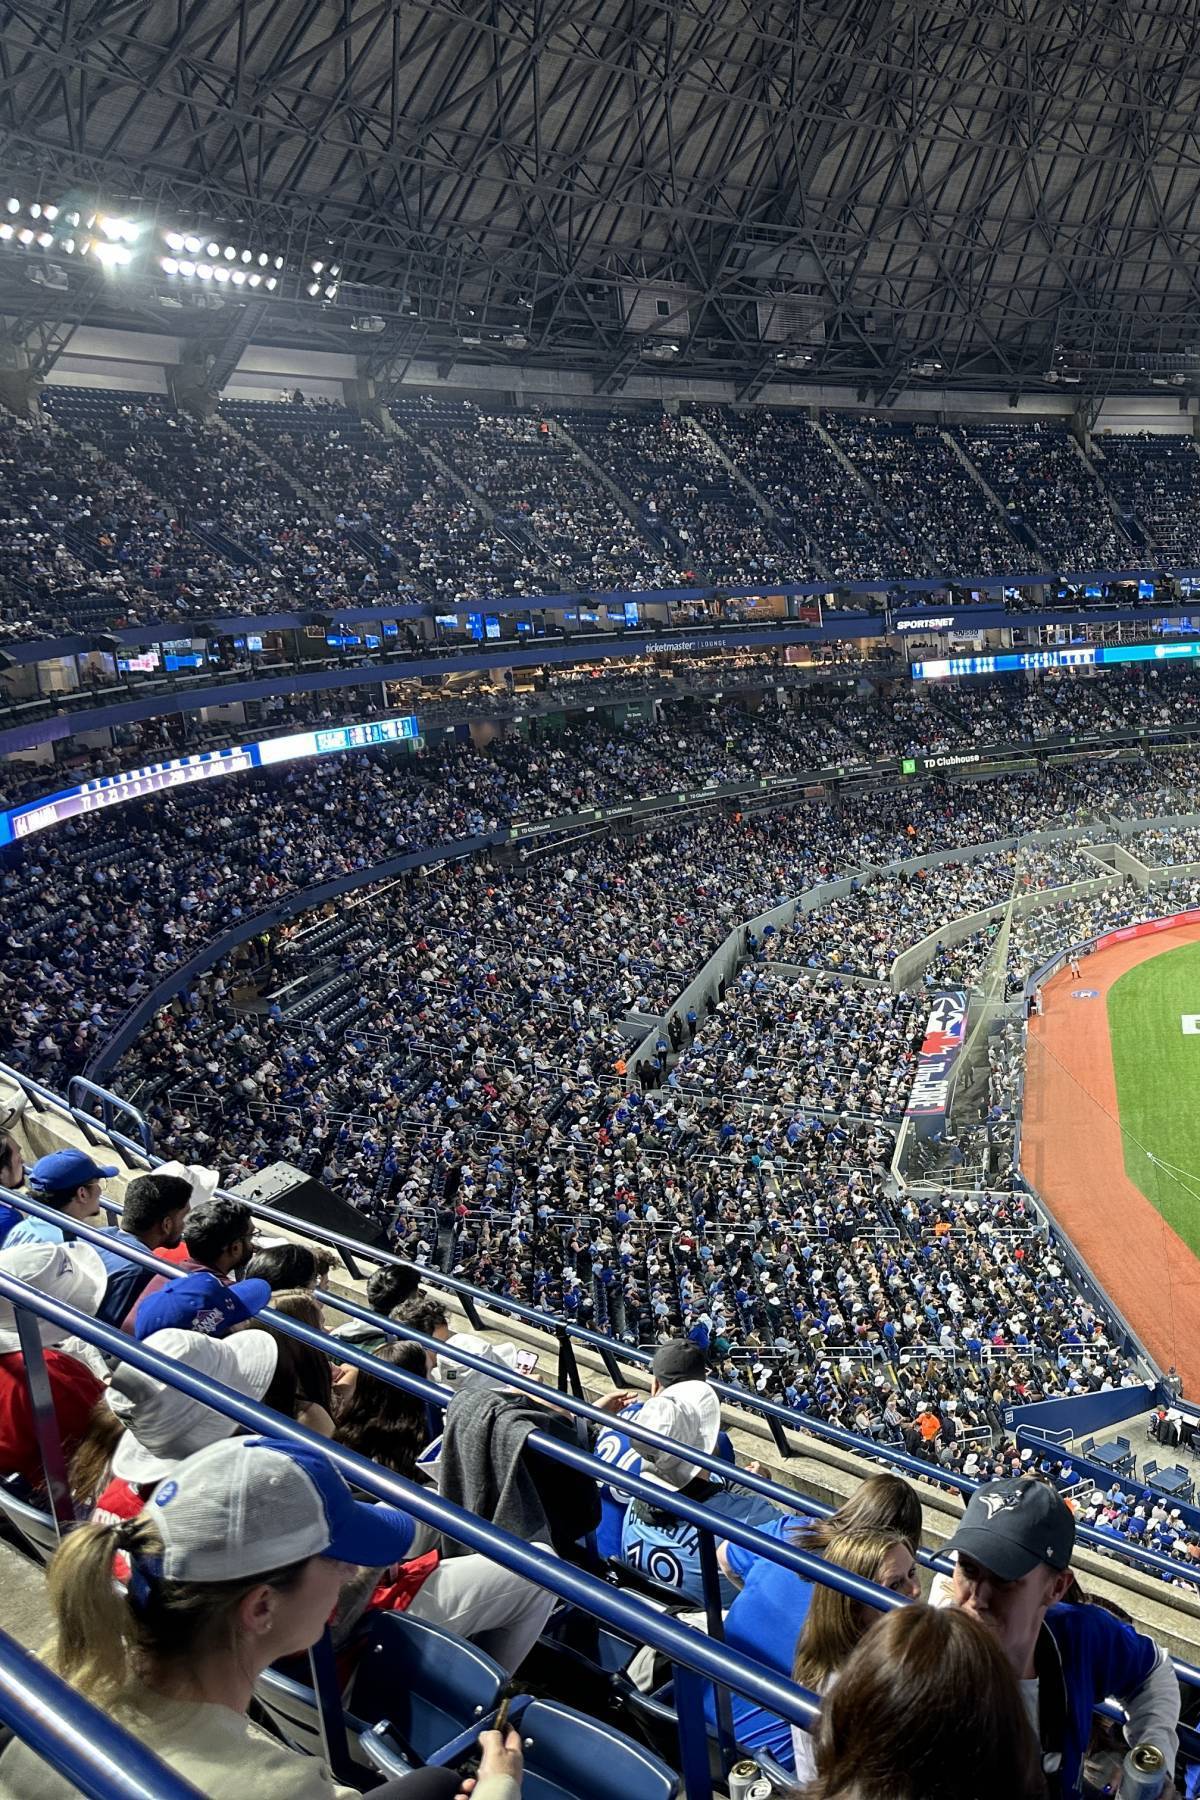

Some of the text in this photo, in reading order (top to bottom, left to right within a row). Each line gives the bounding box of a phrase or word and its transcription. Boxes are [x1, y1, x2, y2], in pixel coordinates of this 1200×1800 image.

[897, 618, 954, 630] SPORTSNET
[645, 640, 727, 653] ticketmaster LOUNGE
[923, 754, 980, 769] TD Clubhouse
[908, 1080, 949, 1109] CORE
